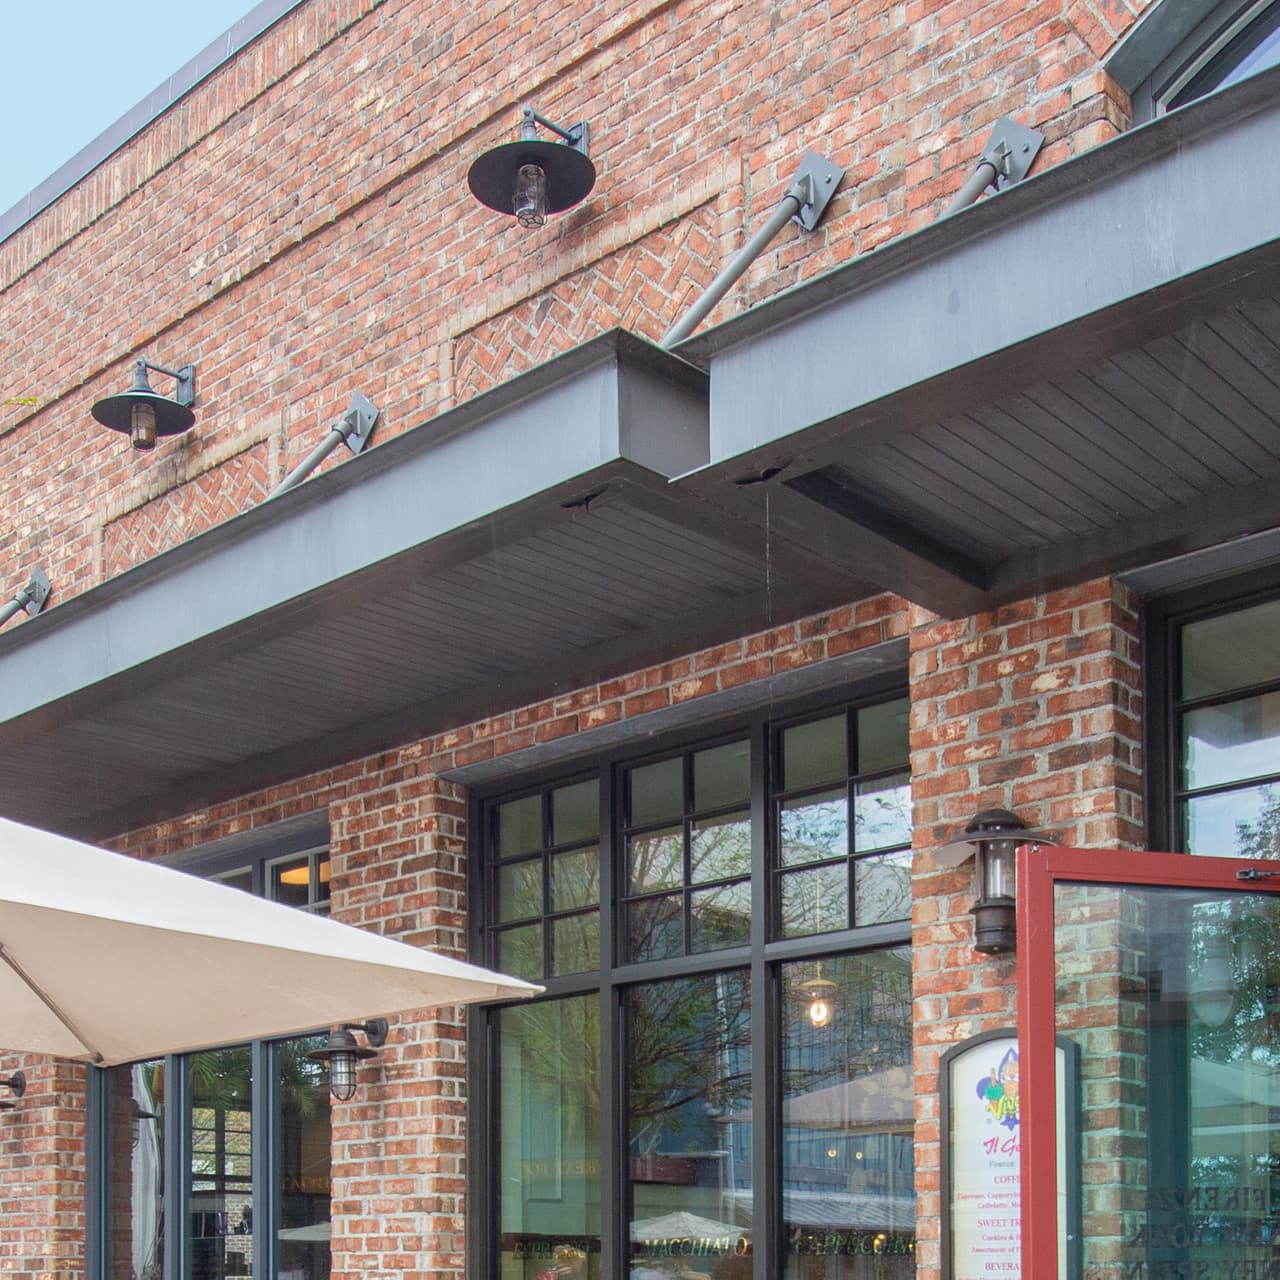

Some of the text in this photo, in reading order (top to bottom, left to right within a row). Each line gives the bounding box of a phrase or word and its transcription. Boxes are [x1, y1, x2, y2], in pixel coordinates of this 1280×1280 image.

[993, 1175, 1021, 1184] COFF
[977, 1219, 1007, 1227] SWEET
[644, 1236, 749, 1257] MACCHIATO
[985, 1262, 1020, 1271] BEVERA
